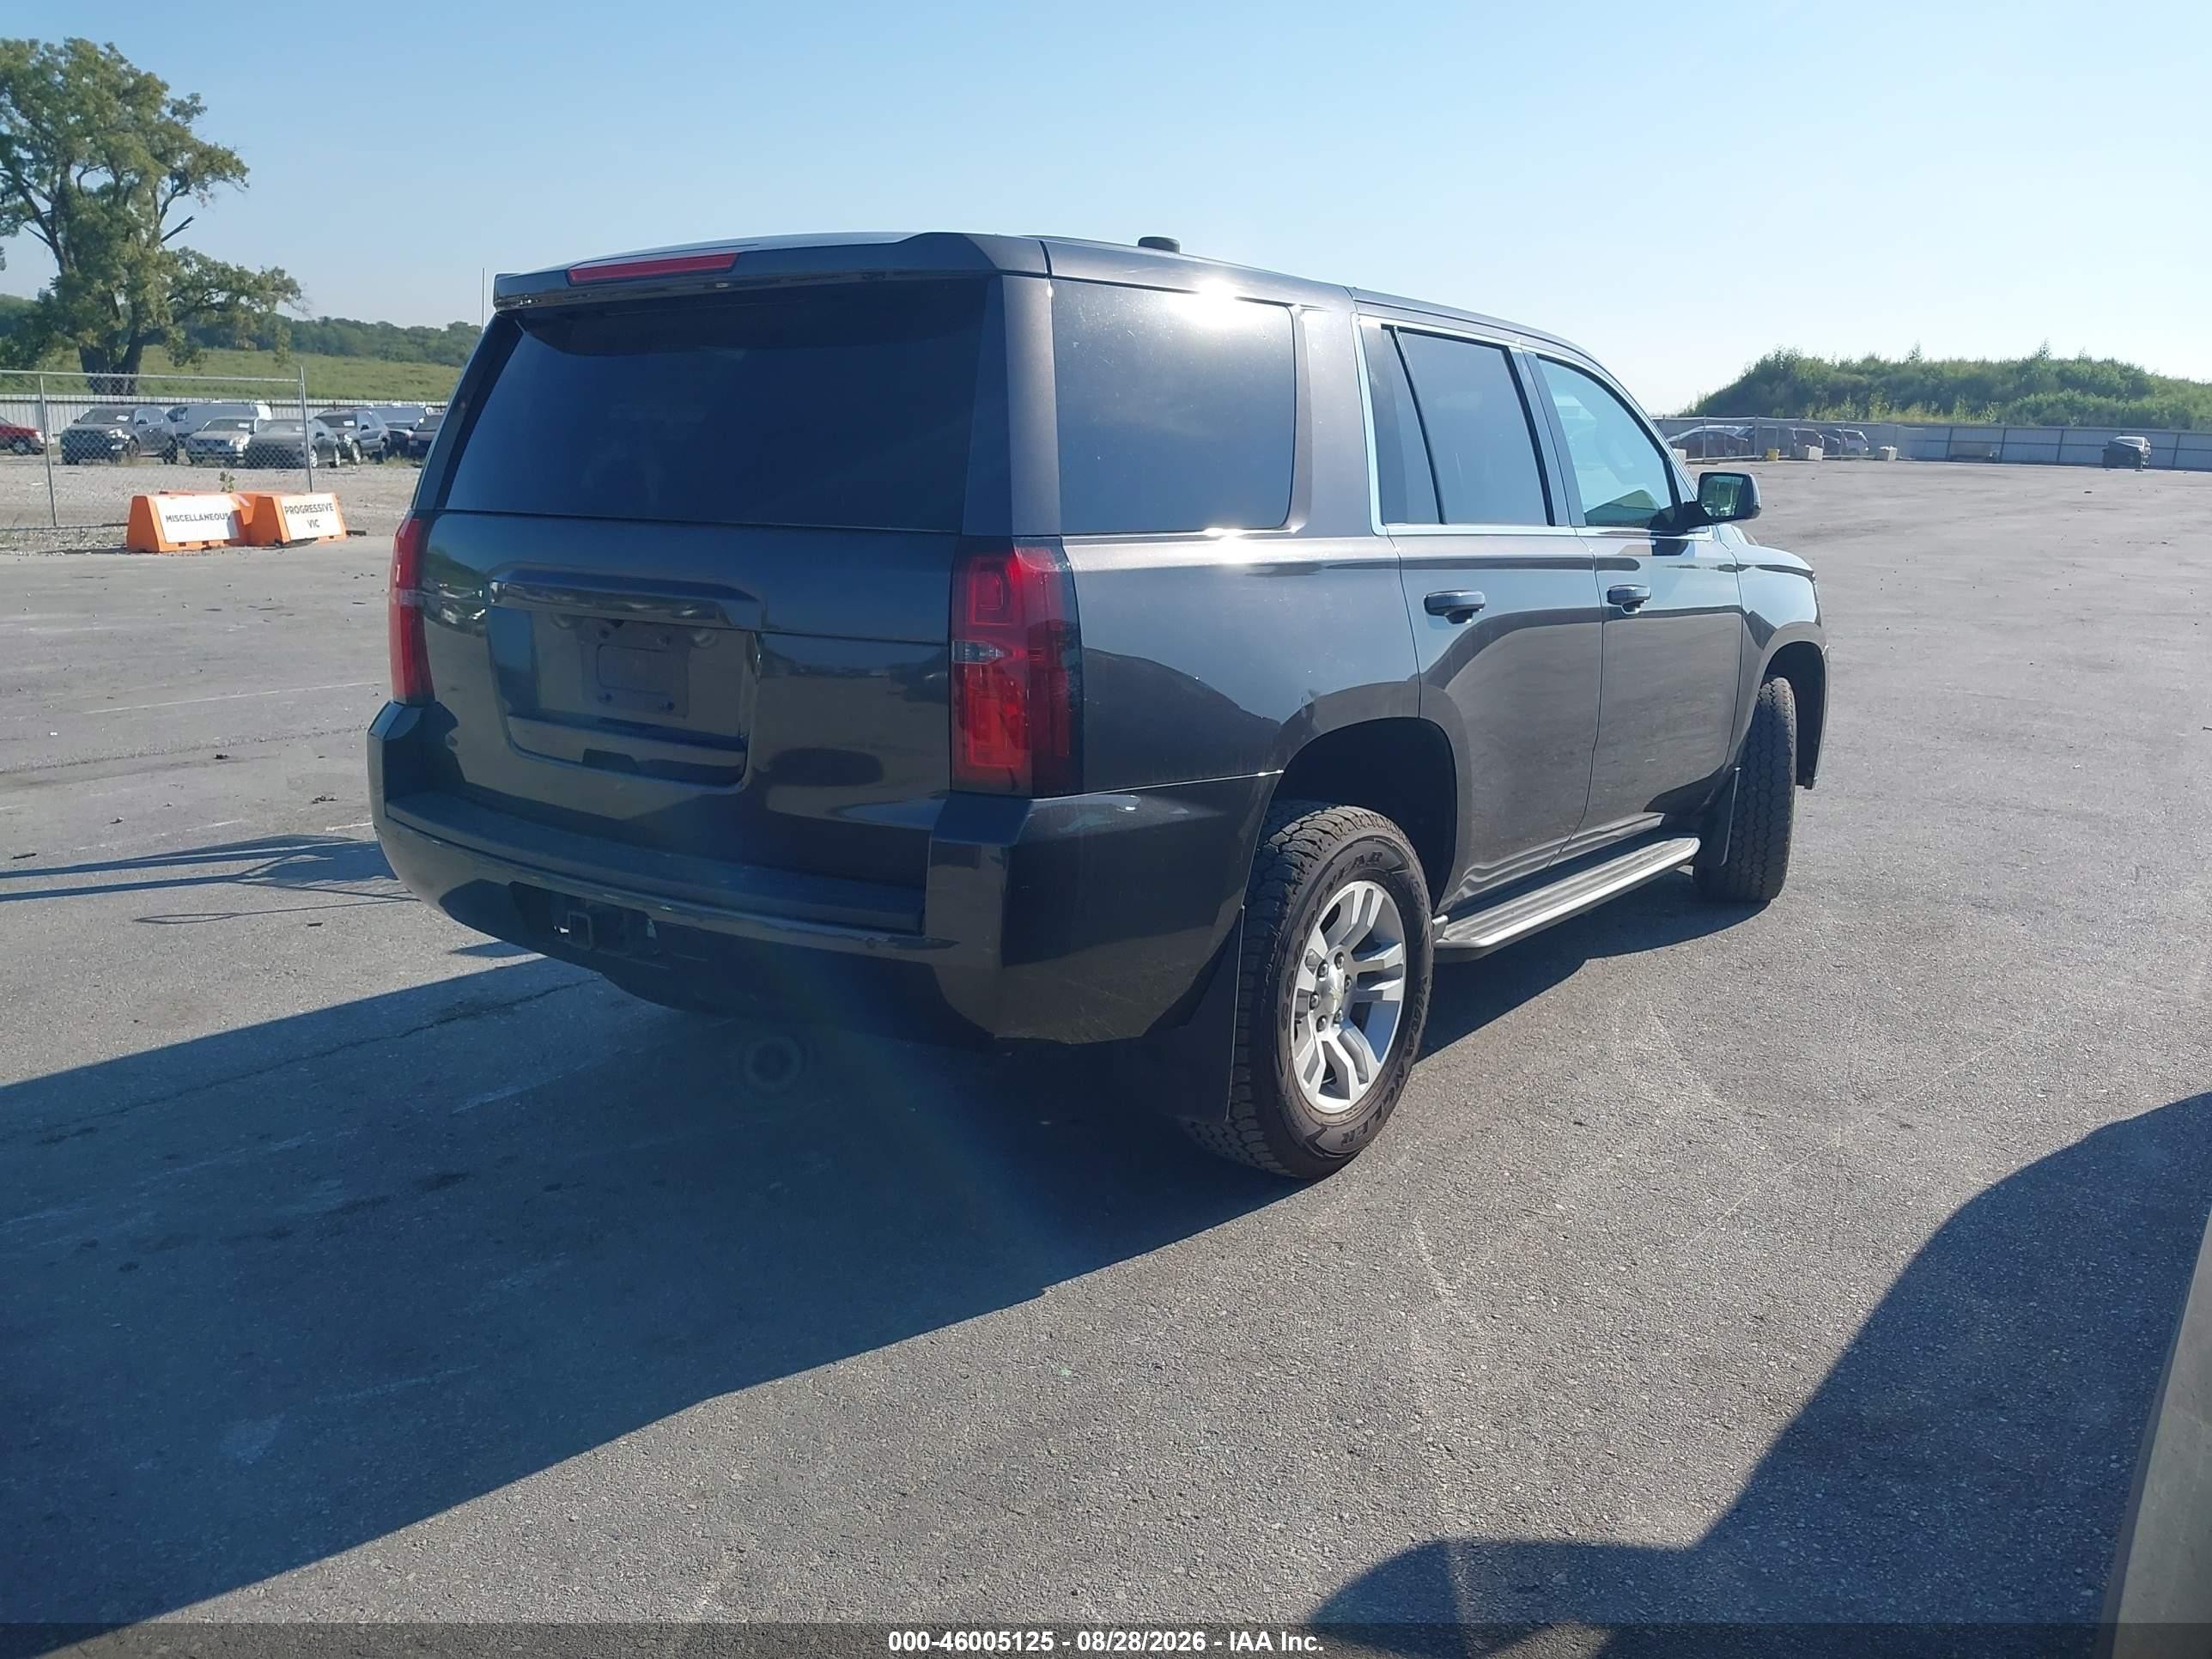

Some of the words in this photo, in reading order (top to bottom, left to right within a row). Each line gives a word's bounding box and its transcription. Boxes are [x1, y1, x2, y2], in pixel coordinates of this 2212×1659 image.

[284, 502, 334, 514] PROGRESSIVE
[166, 513, 231, 523] MISCELLANEOUS
[307, 519, 320, 529] VIC
